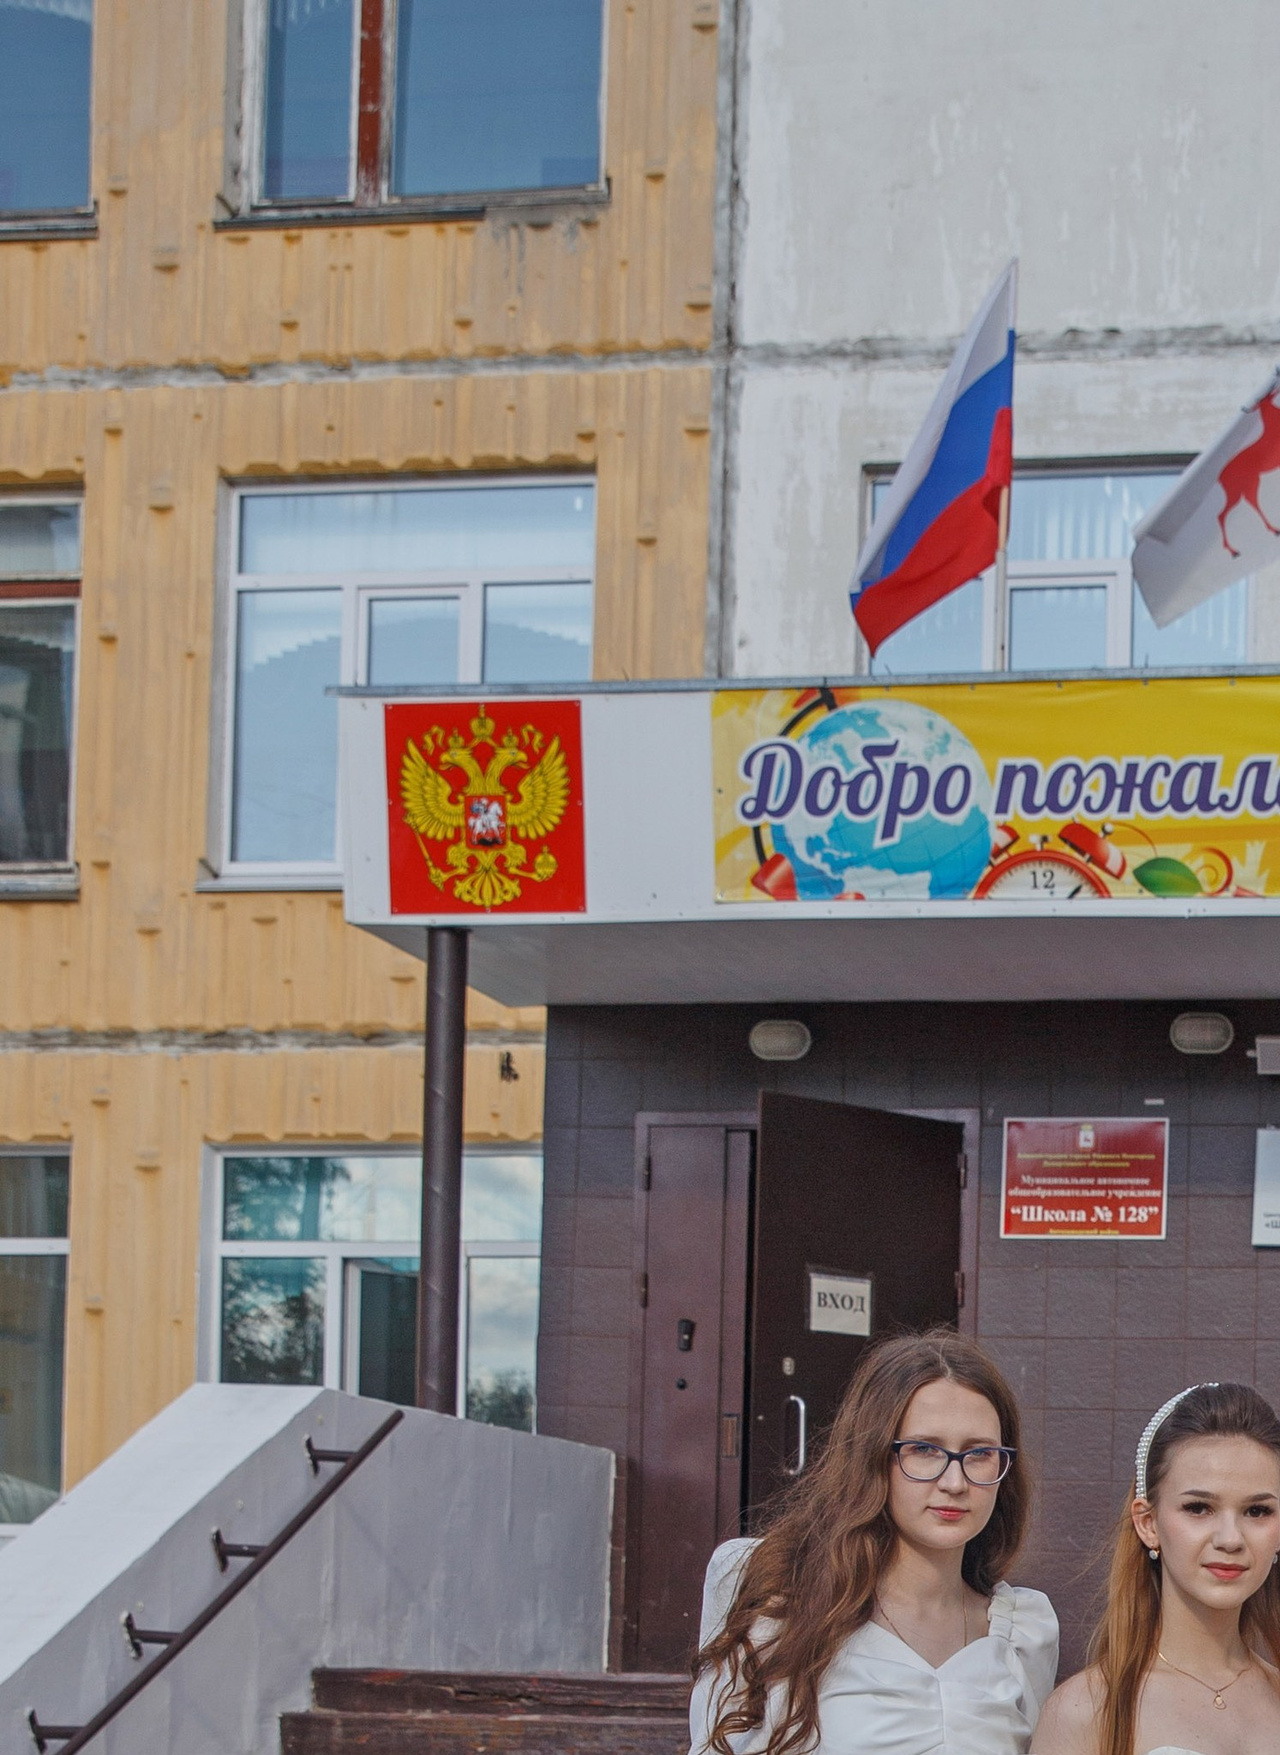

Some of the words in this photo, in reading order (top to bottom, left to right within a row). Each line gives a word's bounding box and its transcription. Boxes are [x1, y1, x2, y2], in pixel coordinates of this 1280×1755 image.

[739, 736, 973, 849] Добро
[1031, 870, 1056, 889] 12
[1091, 1206, 1113, 1222] №
[817, 1291, 866, 1314] ВХОД
